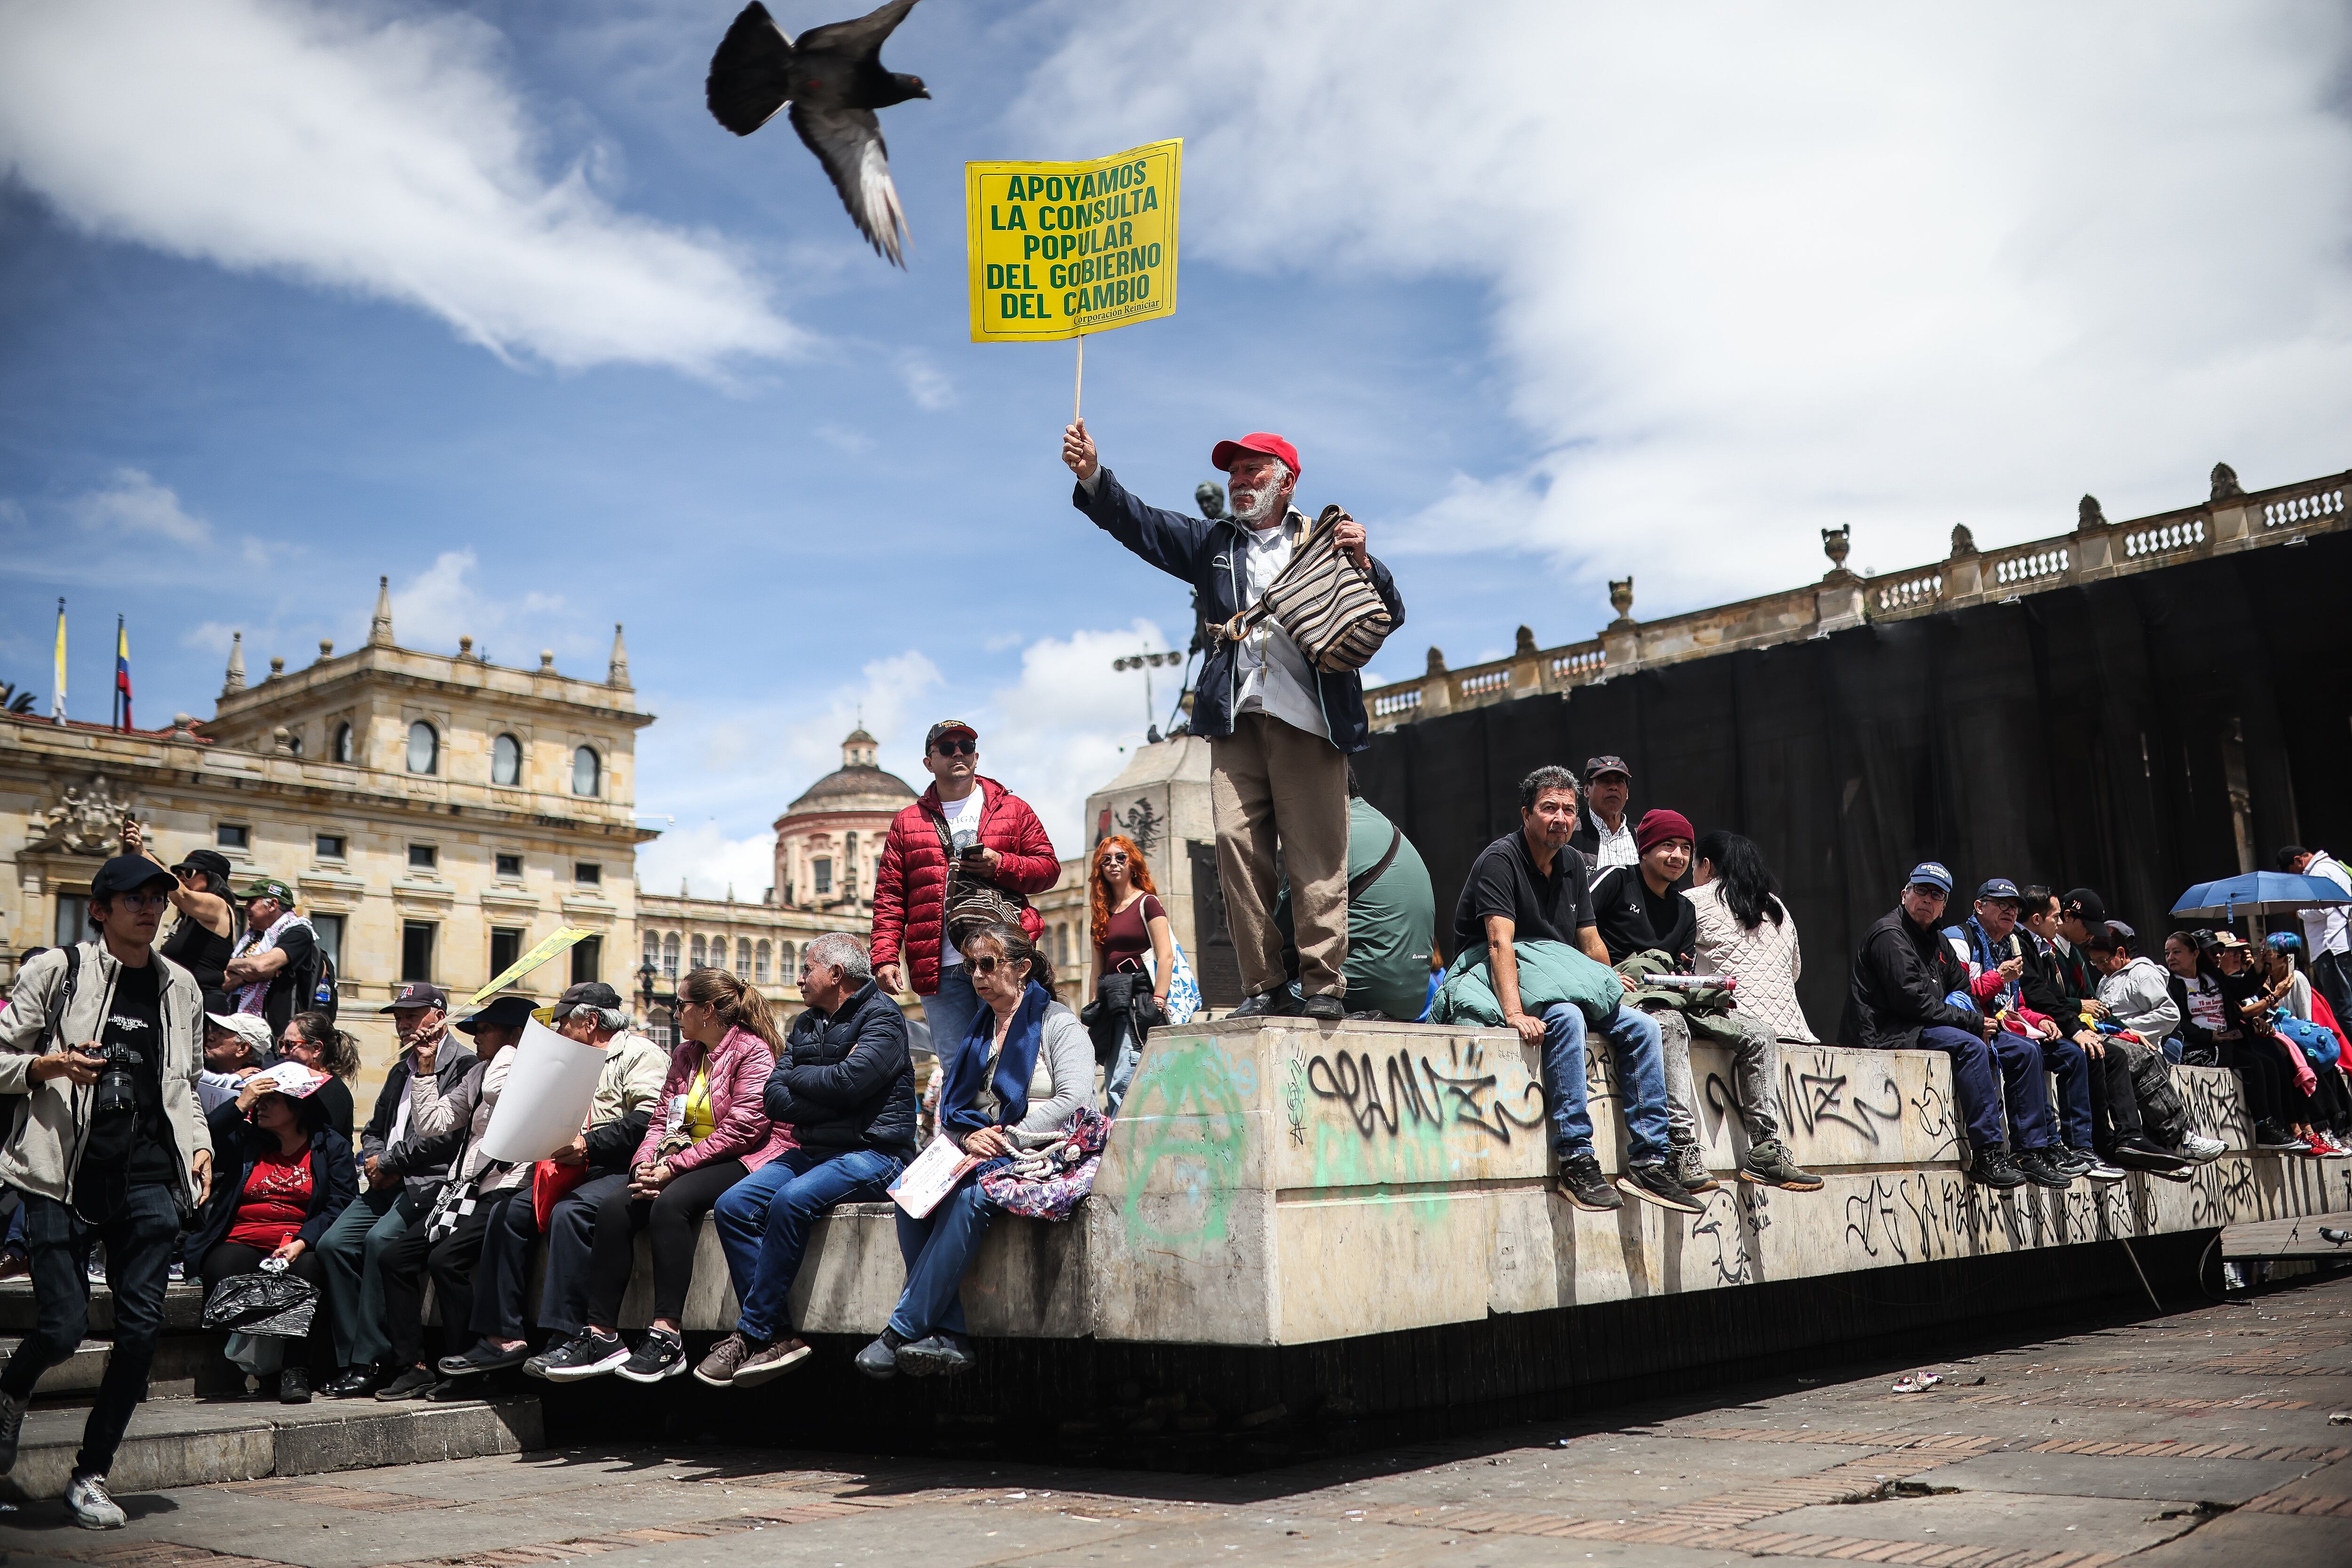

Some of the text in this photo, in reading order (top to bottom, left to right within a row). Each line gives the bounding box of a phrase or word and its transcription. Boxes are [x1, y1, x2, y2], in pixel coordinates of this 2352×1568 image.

[1007, 160, 1146, 201] APOYAMOS
[991, 185, 1158, 231] LA CONSULTA
[1024, 221, 1133, 260] POPULAR
[987, 242, 1161, 290] DEL GOBIERNO
[1001, 274, 1150, 319] DEL CAMBIO
[1073, 299, 1160, 325] Corporación Reiniciar
